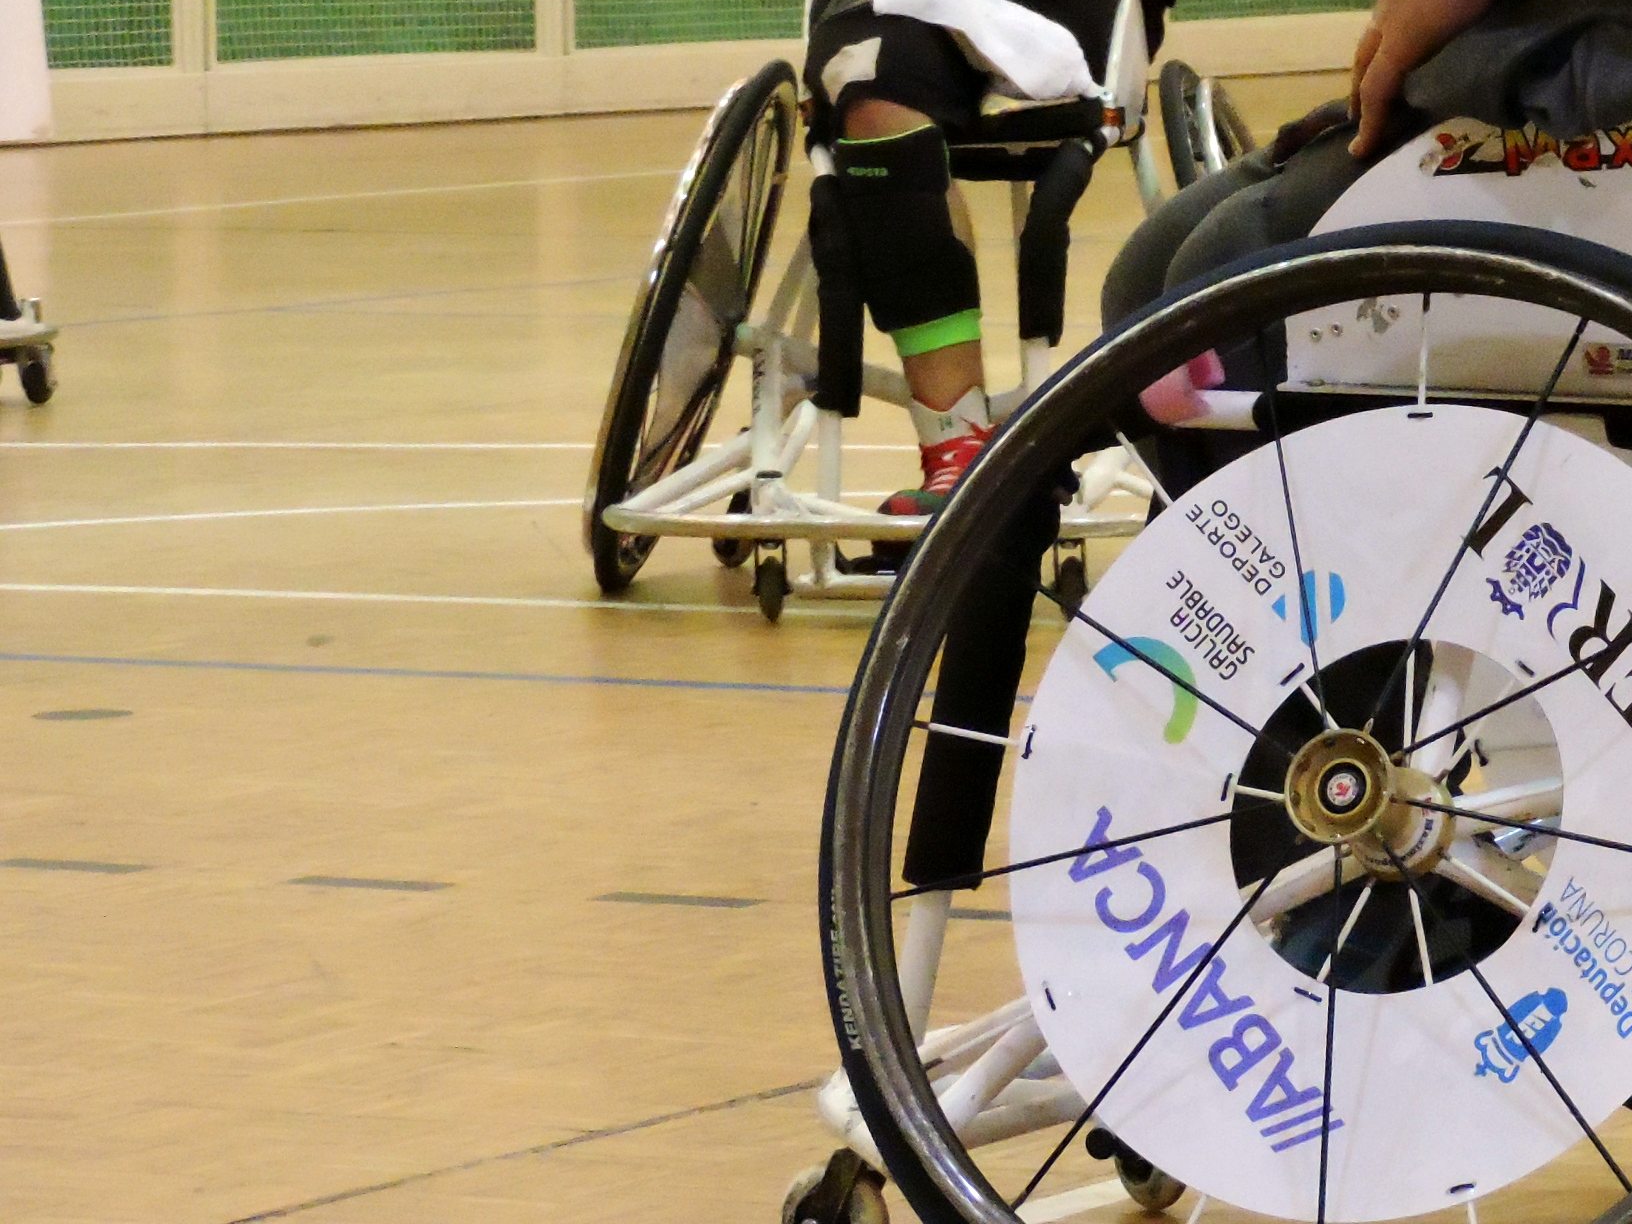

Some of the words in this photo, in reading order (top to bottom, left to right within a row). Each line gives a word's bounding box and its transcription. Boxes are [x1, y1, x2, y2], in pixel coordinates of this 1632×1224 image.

[1185, 504, 1272, 596] DEPORTE
[1211, 500, 1286, 579] GALEGO
[1166, 570, 1256, 666] SAUDABLE
[1170, 607, 1238, 681] GALICIA
[1066, 806, 1336, 1144] ABANCA
